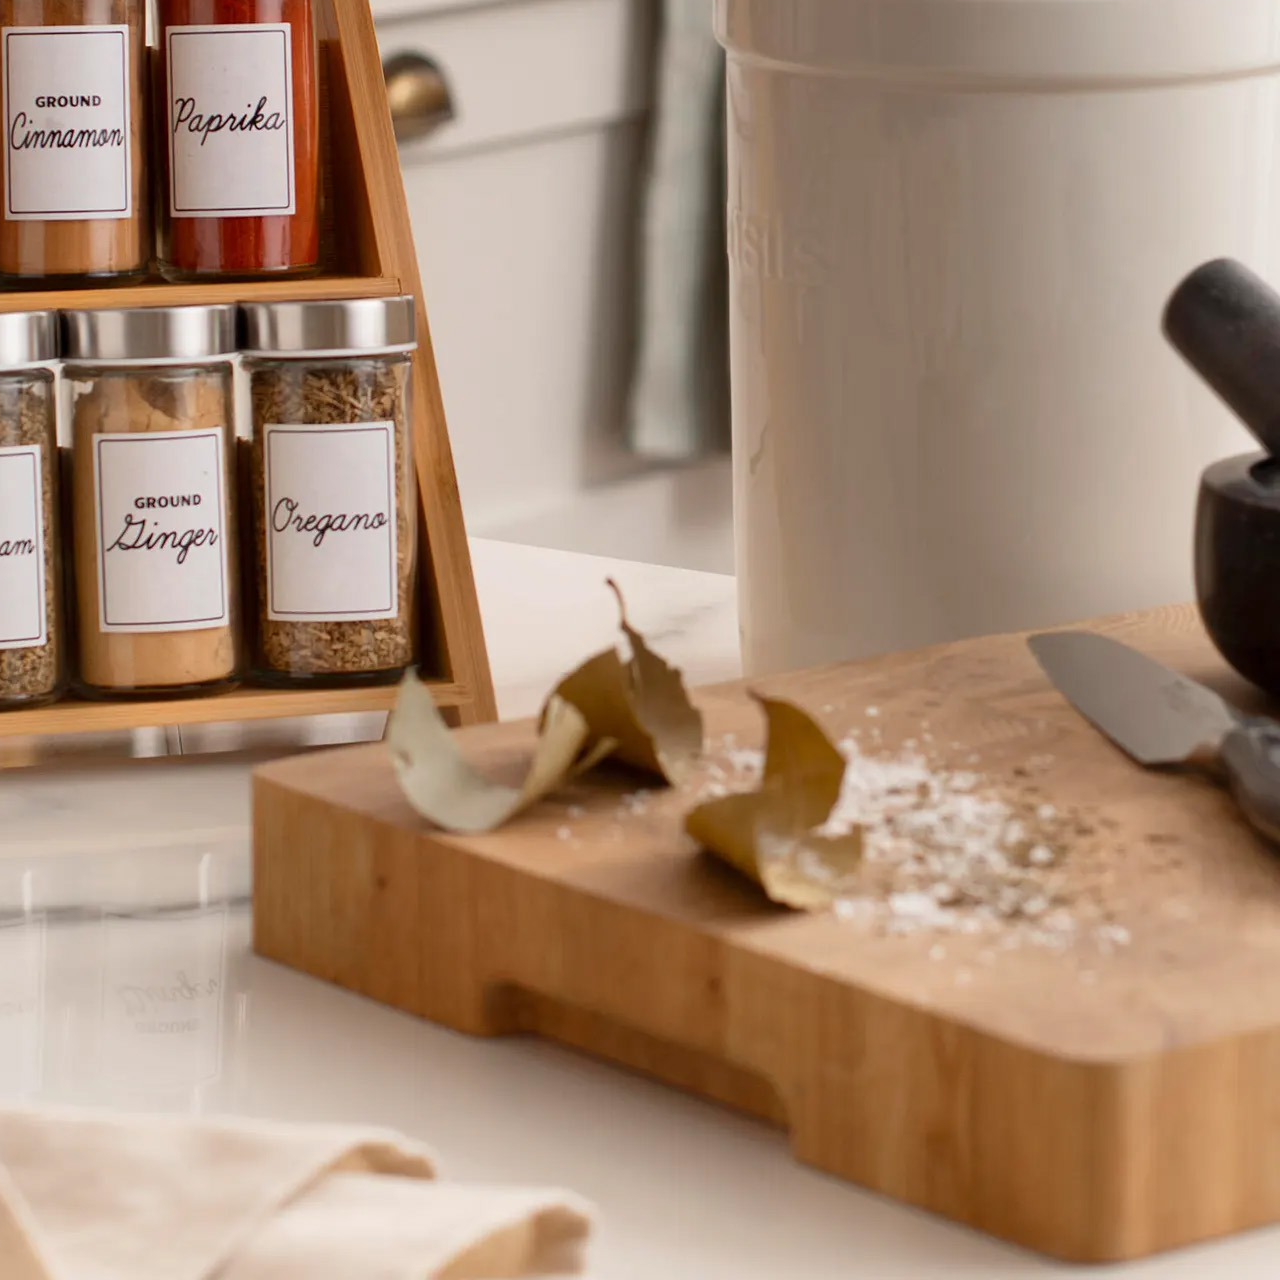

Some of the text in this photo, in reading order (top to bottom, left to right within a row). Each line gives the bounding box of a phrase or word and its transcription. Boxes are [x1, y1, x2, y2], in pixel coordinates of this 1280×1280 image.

[35, 95, 101, 108] GROUND
[174, 96, 285, 146] Paprika
[10, 112, 123, 149] Cinnamon
[134, 494, 201, 509] GROUND
[273, 497, 387, 547] Oregano
[106, 514, 218, 564] Ginger
